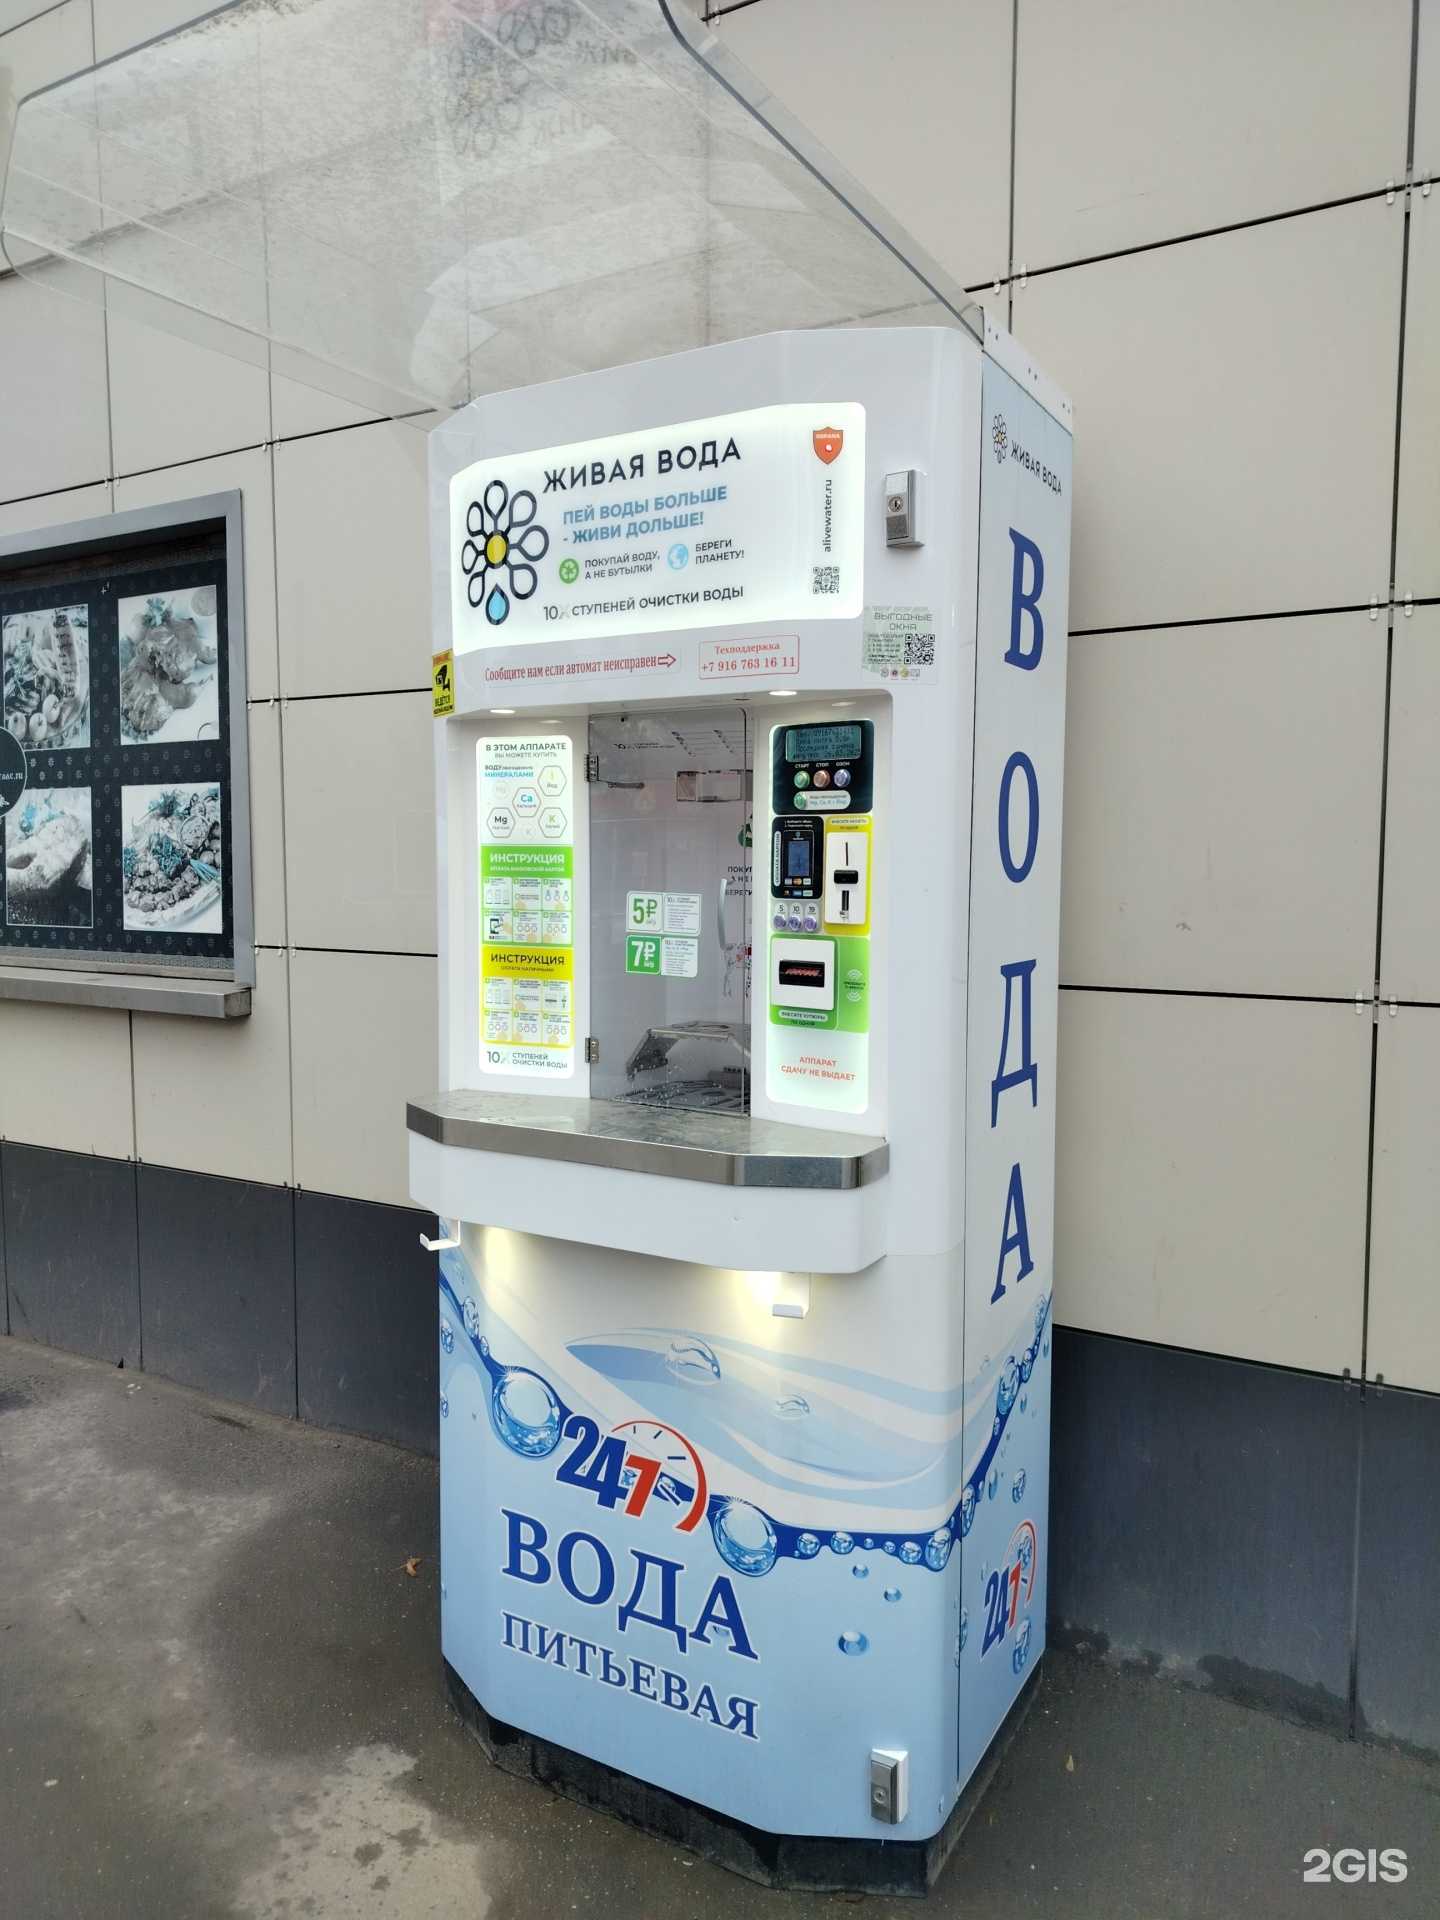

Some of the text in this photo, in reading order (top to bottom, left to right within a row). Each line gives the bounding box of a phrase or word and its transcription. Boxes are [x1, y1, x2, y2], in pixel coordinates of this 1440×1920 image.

[543, 437, 741, 493] ЖИВАЯ ВОДА
[1011, 440, 1062, 496] ЖИВАЯ ВОДА
[563, 486, 728, 525] ПЕЙ ВОДЫ БОЛЬШЕ
[823, 479, 832, 552] alivewater.ru
[573, 525, 621, 544] ЖИВИ
[626, 511, 704, 539] ДОЛЬШЕ!
[695, 539, 732, 552] БЕРЕГИ
[585, 551, 660, 568] ПОКУПАЙ ВОДУ,
[695, 550, 744, 564] ПЛАНЕТУ!
[585, 564, 653, 580] А НЕ БУТЫЛКИ
[572, 597, 635, 616] СТУПЕНЕЙ
[639, 591, 699, 609] ОЧИСТКИ
[703, 586, 744, 602] ВОДЫ
[874, 612, 933, 621] ВЫГОДНЫЕ
[890, 623, 917, 631] ОКНА
[714, 643, 780, 655] Техподдержка
[485, 656, 657, 682] Сообщите нам если автомат неисправен
[702, 656, 795, 673] +7 916 763 16 11
[520, 743, 566, 751] АППАРАТЕ
[494, 816, 508, 825] Mg
[490, 854, 565, 865] ИНСТРУКЦИЯ
[491, 954, 565, 966] ИНСТРУКЦИЯ
[800, 1056, 837, 1067] АППАРАТ
[781, 1065, 856, 1081] СДАЧУ НЕ ВЫДАЕТ
[501, 1508, 759, 1661] ВОДА
[501, 1610, 759, 1740] ПИТЬЕВАЯ
